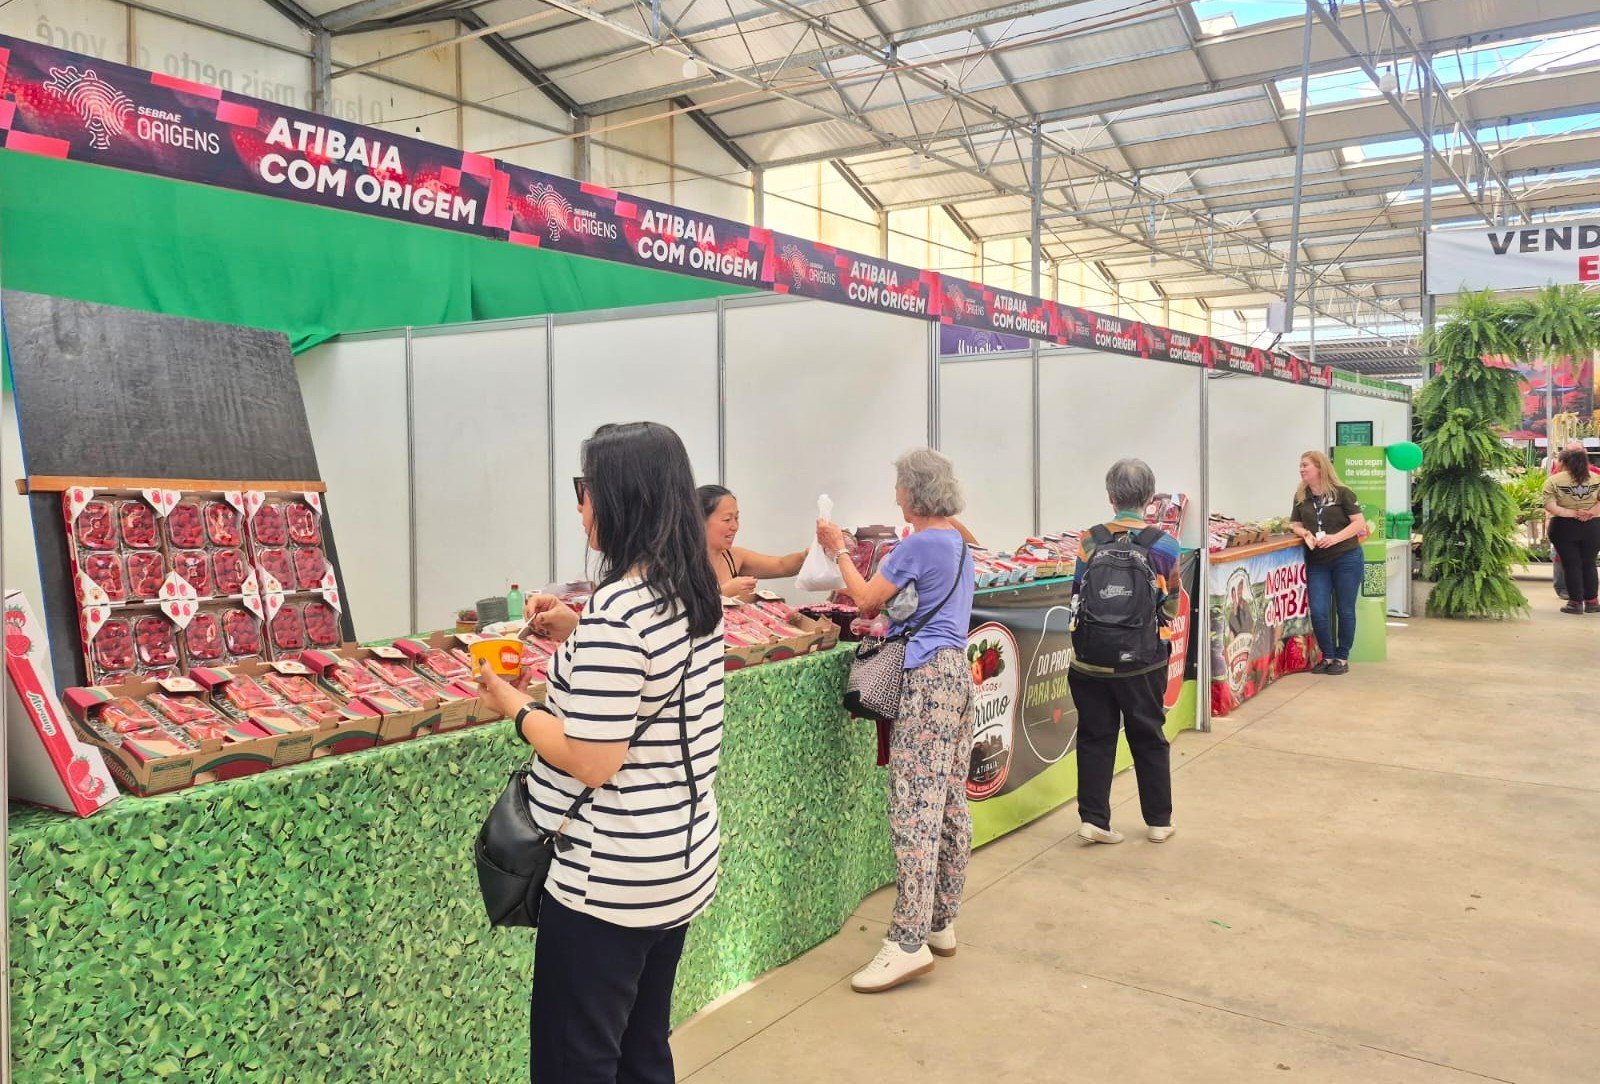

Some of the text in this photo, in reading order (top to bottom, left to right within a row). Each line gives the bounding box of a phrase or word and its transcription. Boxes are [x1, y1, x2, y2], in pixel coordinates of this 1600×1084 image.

[137, 106, 182, 124] SEBRAE
[137, 118, 220, 154] ORIGENS
[265, 117, 403, 175] ATIBAIA
[259, 153, 477, 225] COM ORIGEM
[573, 217, 617, 240] ORIGENS
[640, 210, 716, 245] ATIBAIA
[1487, 225, 1600, 255] VEND
[638, 237, 758, 280] COM ORIGEM
[808, 268, 836, 286] ORIGENS
[850, 261, 898, 286] ATIBAIA
[848, 282, 926, 314] COM ORIGEM
[994, 294, 1028, 314] ATIBAIA
[992, 312, 1048, 335] COM ORIGEM
[1096, 318, 1121, 333] ATIBAIA
[1095, 333, 1137, 351] COM ORIGEM
[1036, 653, 1049, 677] DO
[1026, 676, 1068, 708] PARA SUA
